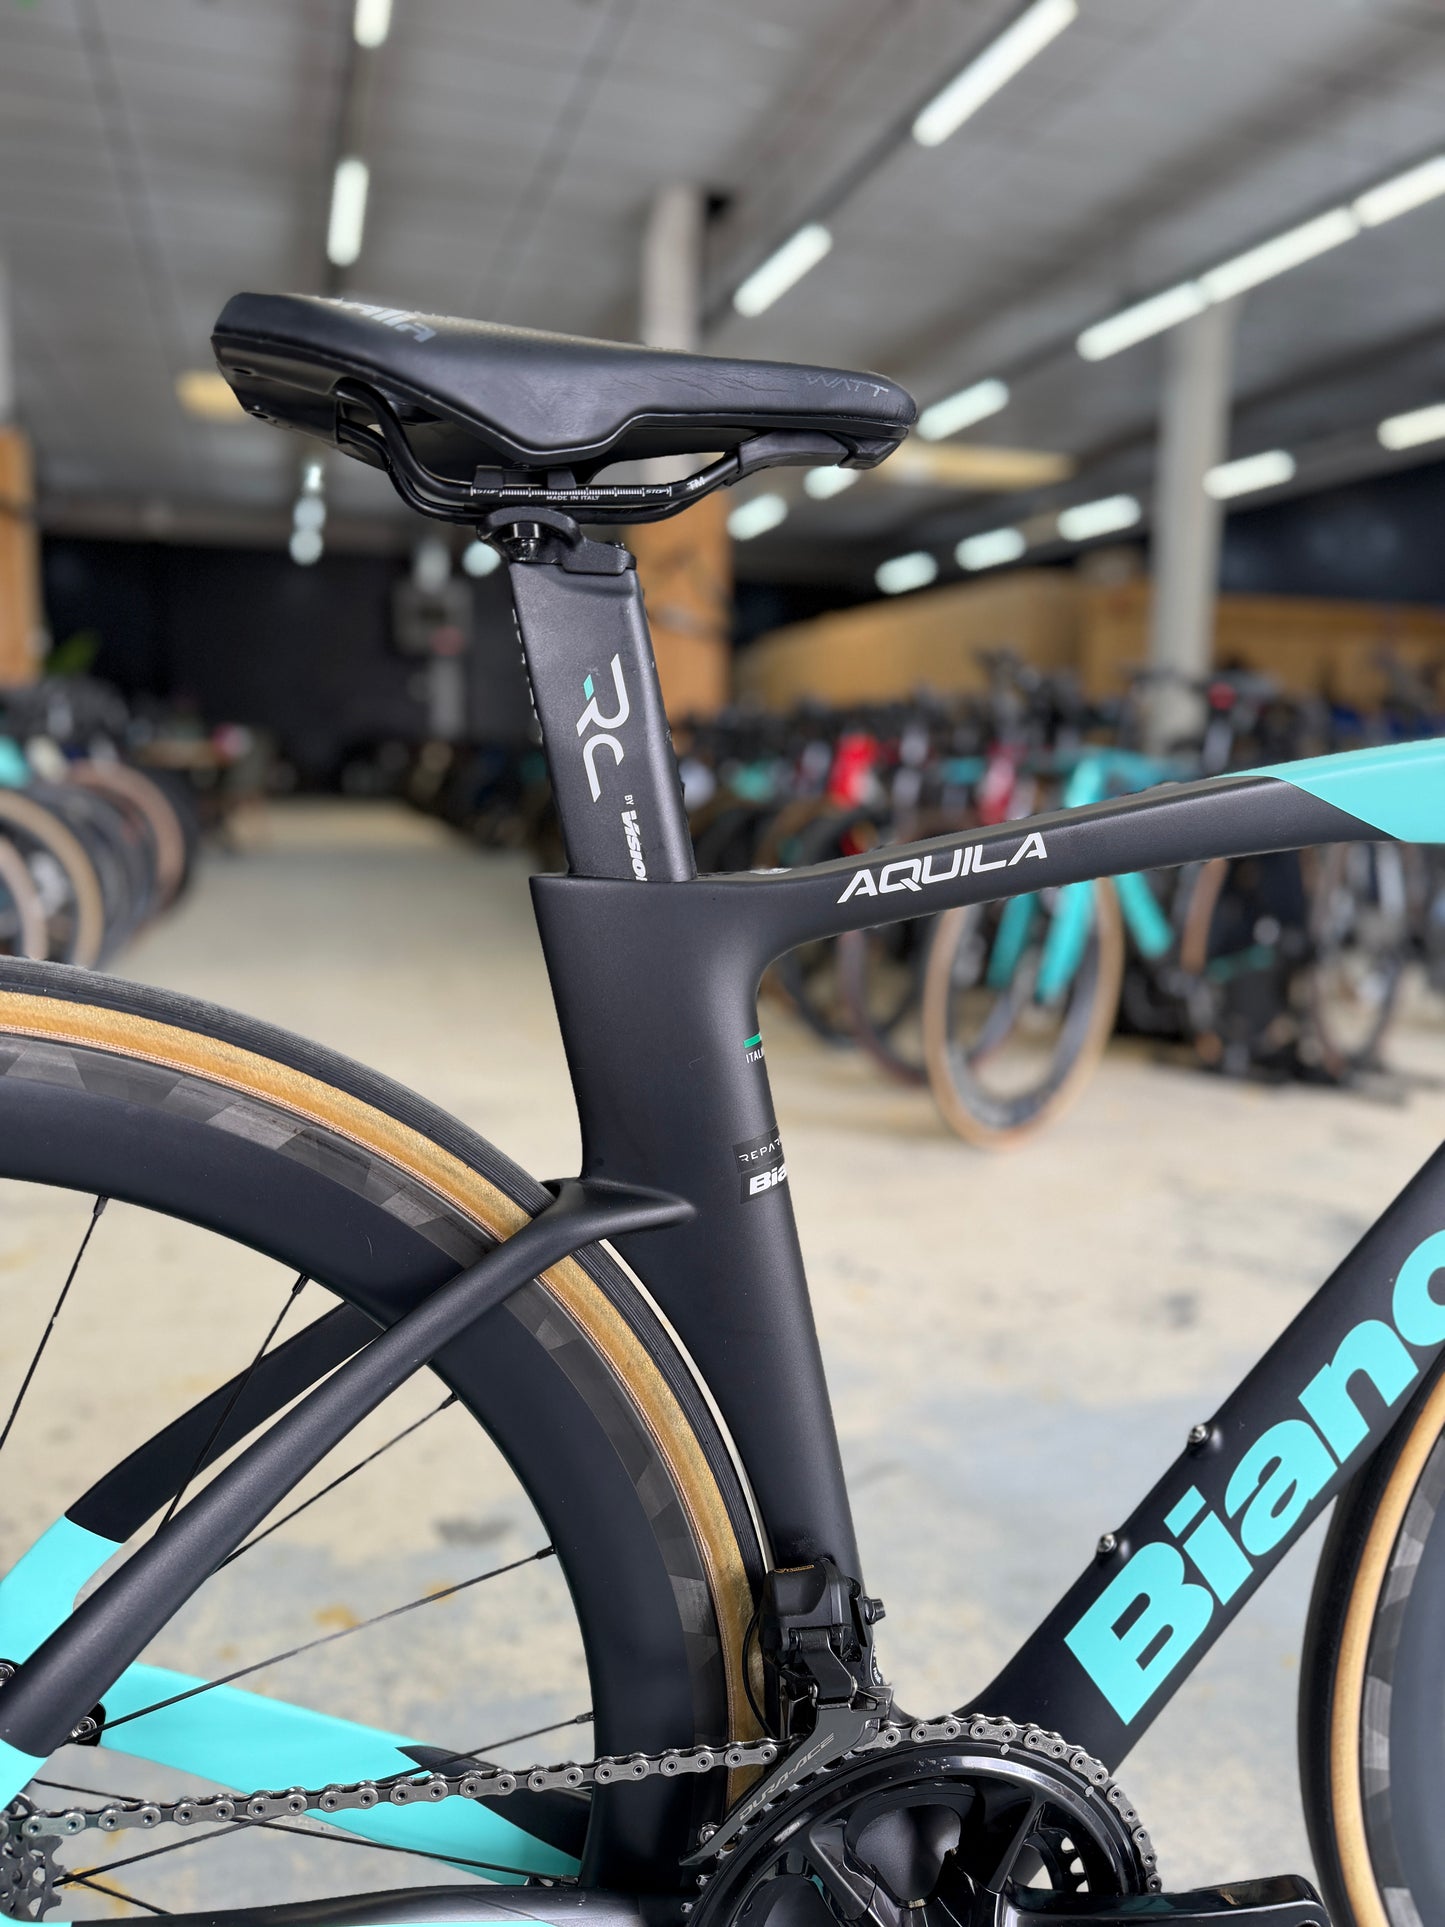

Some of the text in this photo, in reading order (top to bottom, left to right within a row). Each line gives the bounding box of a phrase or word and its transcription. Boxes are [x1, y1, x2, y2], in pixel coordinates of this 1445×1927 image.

[806, 374, 889, 397] WATT
[576, 653, 630, 803] RC
[624, 794, 634, 805] BY
[836, 831, 1048, 904] AQUILA
[739, 1732, 835, 1820] DURA-ACE
